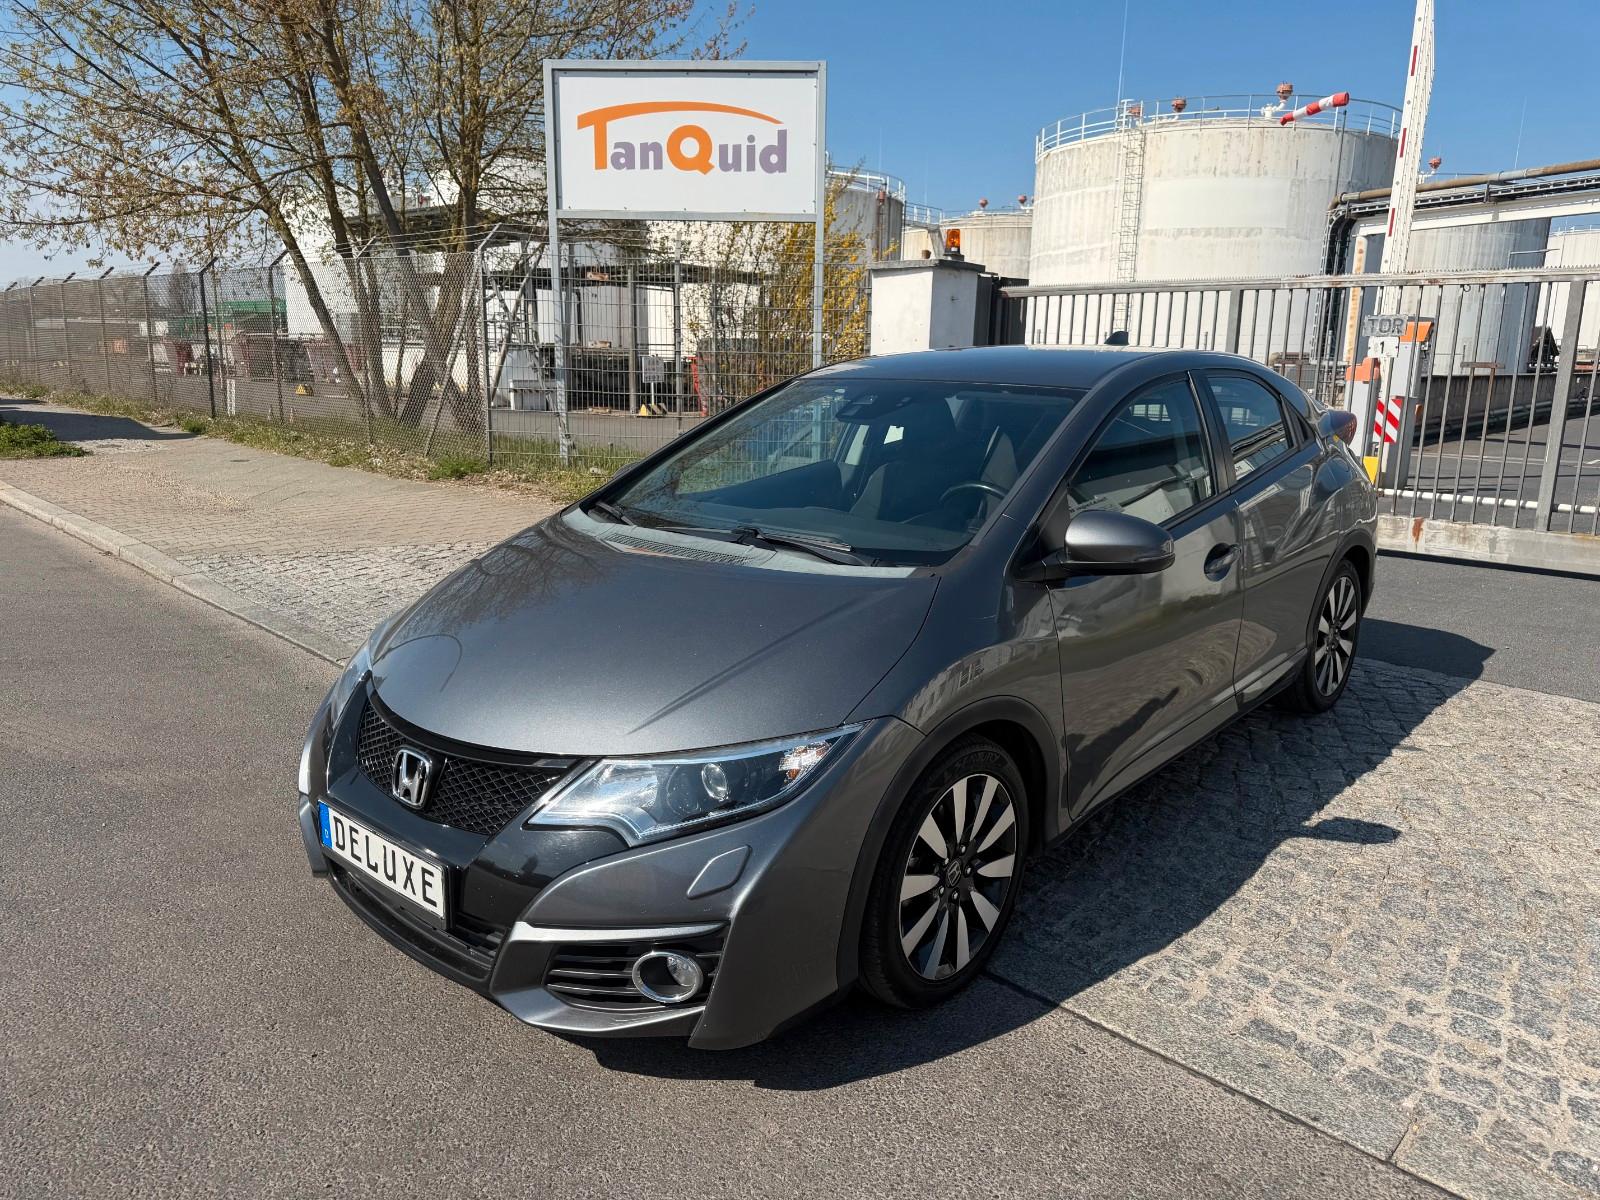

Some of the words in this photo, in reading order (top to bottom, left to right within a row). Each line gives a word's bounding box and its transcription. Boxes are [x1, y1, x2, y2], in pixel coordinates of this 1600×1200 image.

[577, 101, 788, 175] TanQuid
[1367, 317, 1403, 333] TOR
[333, 815, 437, 908] DELUXE
